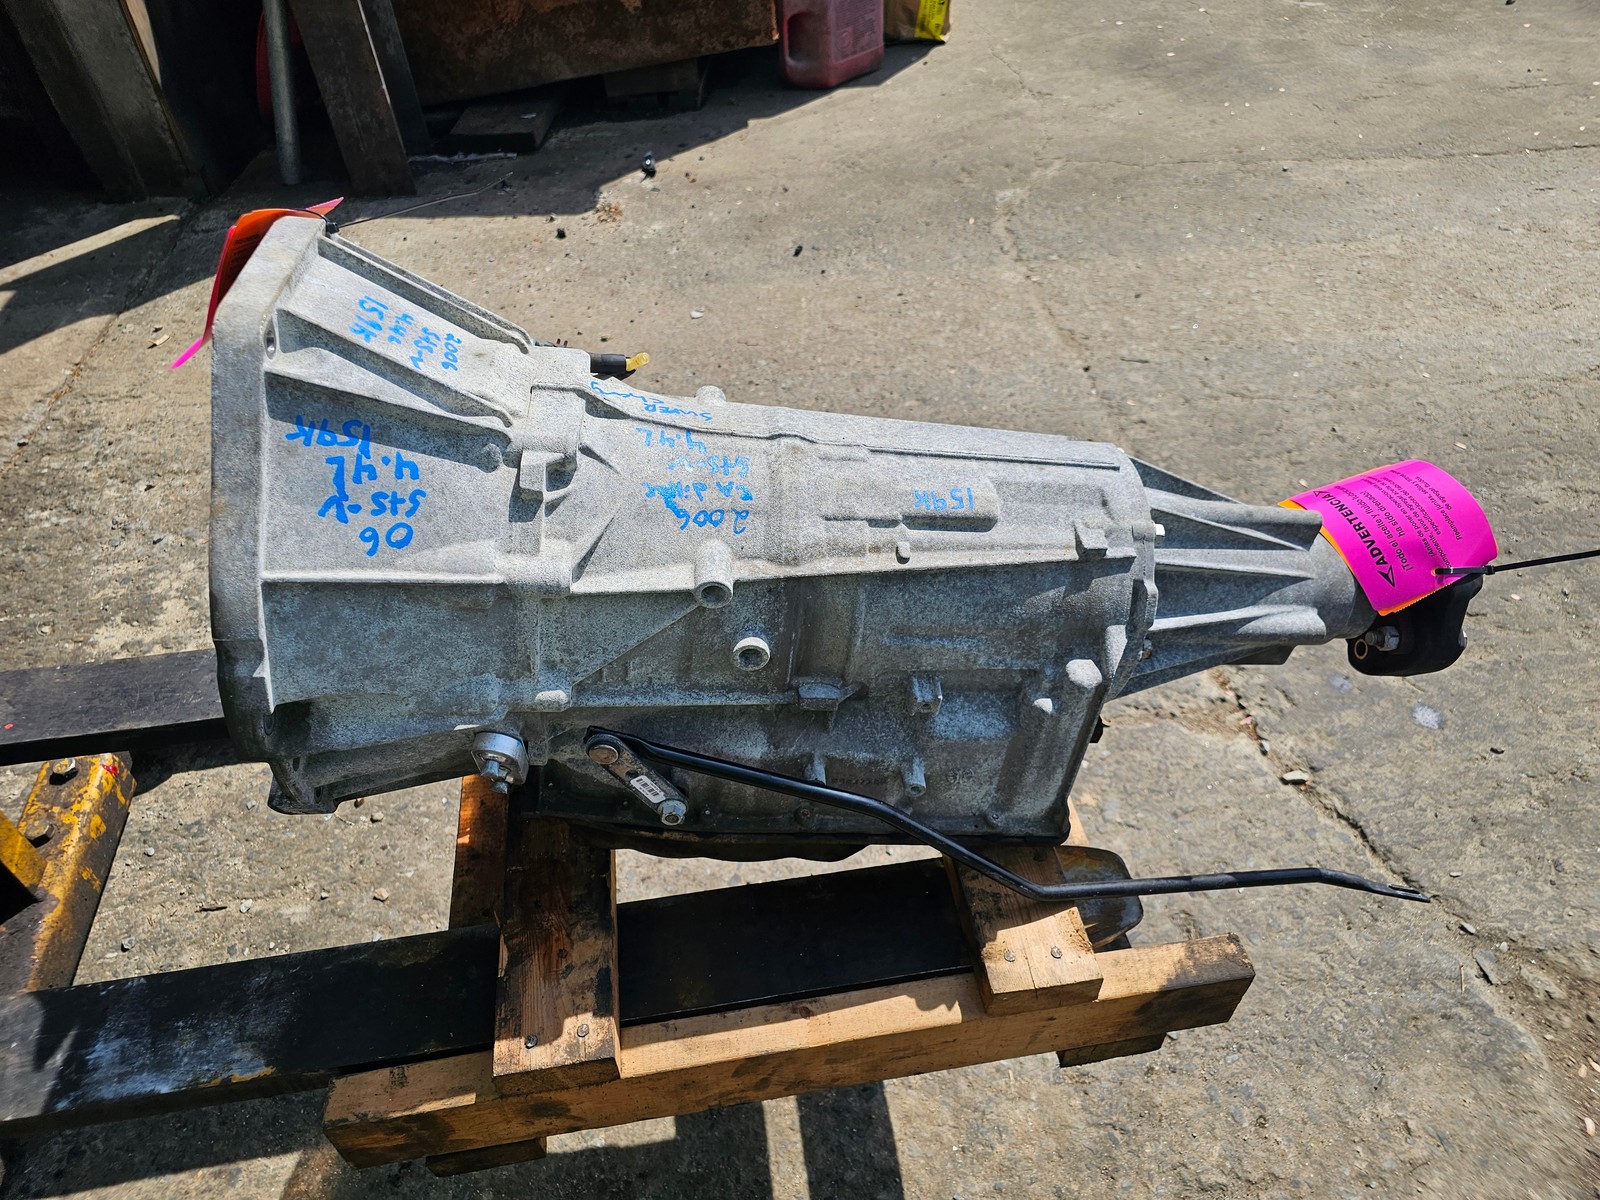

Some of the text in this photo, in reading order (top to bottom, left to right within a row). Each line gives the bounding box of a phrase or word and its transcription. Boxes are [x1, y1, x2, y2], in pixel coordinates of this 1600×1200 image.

[441, 333, 463, 371] 2006
[285, 414, 371, 459] 159K
[325, 451, 420, 497] 4.4L
[913, 487, 975, 511] 159K
[670, 506, 750, 535] 2006
[1322, 493, 1388, 565] ADVERTENCIA
[1376, 519, 1393, 539] aceite
[1384, 512, 1398, 526] sido
[1395, 526, 1405, 537] ha
[1405, 516, 1420, 530] poner
[1440, 510, 1461, 540] Reemplace
[359, 521, 414, 557] 06
